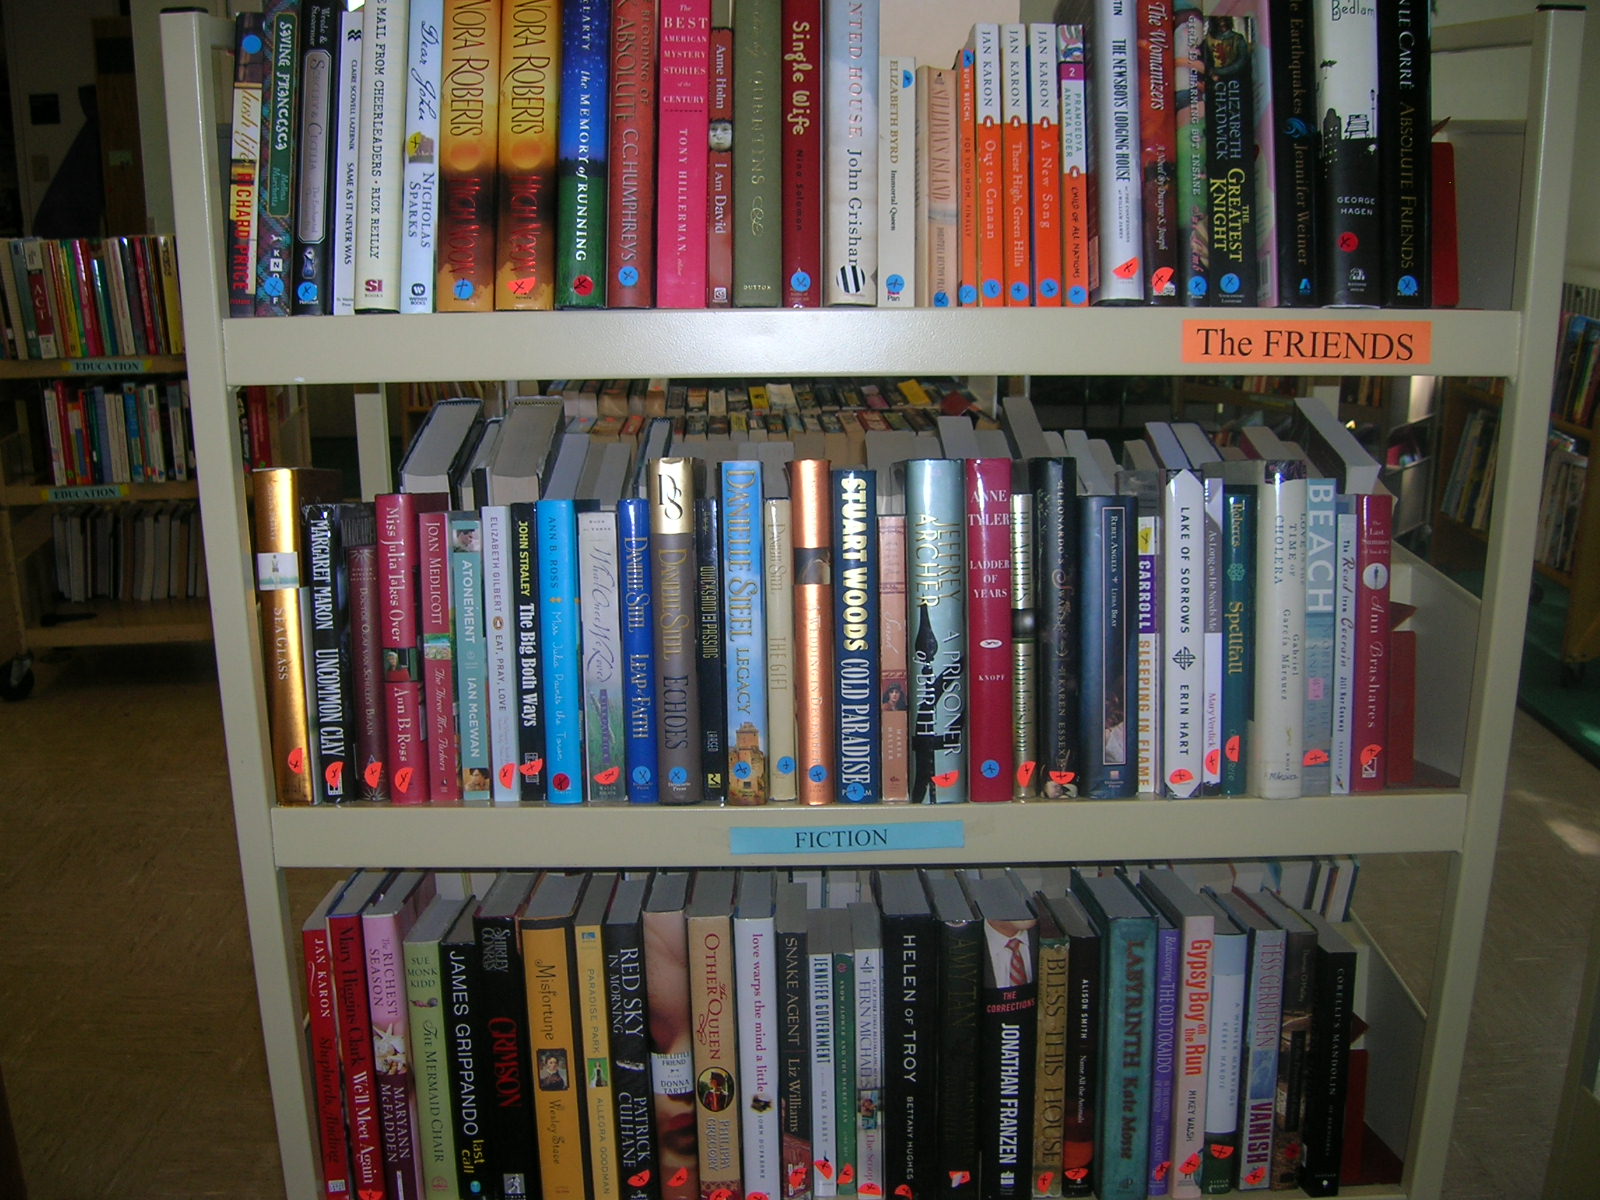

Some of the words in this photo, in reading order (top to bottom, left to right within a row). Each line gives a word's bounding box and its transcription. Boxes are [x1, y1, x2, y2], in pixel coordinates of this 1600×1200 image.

[376, 7, 386, 39] MAIL
[664, 17, 708, 28] BEST
[1148, 3, 1166, 26] The
[374, 44, 385, 76] FROM
[716, 44, 727, 75] Anne
[784, 21, 812, 82] Single
[981, 30, 992, 54] JAN
[1009, 30, 1019, 54] JAN
[1038, 30, 1049, 54] JAN
[580, 70, 591, 89] the
[983, 61, 993, 107] KARON
[1010, 61, 1020, 108] KARON
[1039, 61, 1049, 108] KARON
[1148, 29, 1167, 111] Womanizers
[716, 78, 727, 109] Holm
[787, 90, 811, 135] Wife
[889, 60, 898, 127] ELIZABETH
[371, 80, 384, 176] CHEERLEADERS
[578, 94, 591, 163] MEMORY
[1215, 82, 1227, 160] CHADWICK
[889, 129, 898, 164] BYRD
[1399, 102, 1413, 189] ABSOLUTE
[576, 167, 588, 180] of
[847, 149, 861, 191] John
[1294, 143, 1308, 209] Jennifer
[345, 187, 352, 201] AS
[370, 187, 381, 216] RICK
[408, 181, 422, 238] SPARKS
[420, 171, 435, 248] NICHOLAS
[1210, 178, 1226, 251] KNIGHT
[344, 214, 352, 242] NEVER
[575, 183, 588, 261] RUNNING
[1227, 168, 1245, 262] GREATEST
[1400, 195, 1412, 269] FRIENDS
[344, 244, 352, 265] WAS
[369, 219, 380, 259] REILLY
[1297, 211, 1309, 265] Weiner
[1197, 328, 1252, 356] The
[1263, 330, 1413, 360] FRIENDS
[76, 362, 140, 371] EDUCATION
[54, 488, 116, 499] EDUCATION
[385, 507, 400, 537] Miss
[425, 522, 440, 552] JOAN
[518, 520, 529, 549] JOHN
[725, 469, 757, 573] DANIELLE
[841, 475, 869, 562] STUART
[967, 513, 1010, 526] TYLER
[1180, 507, 1191, 540] LAKE
[310, 519, 329, 583] MARGARET
[381, 539, 405, 569] Julia
[490, 516, 499, 569] ELIZABETH
[915, 513, 939, 609] ARCHER
[1180, 546, 1191, 561] OF
[1308, 484, 1334, 613] BEACH
[519, 551, 531, 596] STRALEY
[969, 560, 1010, 569] LADDER
[313, 586, 333, 630] MARON
[387, 570, 404, 606] Takes
[428, 557, 443, 625] MEDLICOTT
[462, 560, 476, 643] ATONEMENT
[492, 572, 502, 612] GILBERT
[699, 565, 718, 612] QUICKSAND
[972, 589, 1007, 599] YEARS
[1138, 560, 1151, 629] CARROLL
[1180, 567, 1191, 634] SORROWS
[389, 609, 404, 641] Over
[519, 603, 534, 629] The
[729, 577, 758, 642] STEEL
[842, 567, 869, 651] WOODS
[518, 631, 536, 655] Big
[701, 623, 718, 659] PASSING
[942, 629, 960, 643] A
[1224, 602, 1245, 675] Spellfall
[522, 658, 537, 689] Both
[629, 654, 649, 687] LEAP
[841, 658, 870, 700] COLD
[913, 651, 929, 667] of
[1138, 640, 1151, 712] SLEEPING
[315, 649, 342, 722] UNCOMMON
[393, 687, 407, 716] Ann
[467, 677, 478, 700] IAN
[736, 648, 751, 716] LEGACY
[1180, 684, 1190, 715] ERIN
[520, 693, 538, 727] Ways
[631, 697, 650, 739] FAITH
[663, 675, 689, 750] ECHOES
[915, 674, 936, 736] BIRTH
[942, 651, 961, 756] PRISONER
[1206, 692, 1217, 715] Mary
[320, 727, 345, 757] CLAY
[397, 719, 409, 732] B.
[468, 703, 480, 758] McEWAN
[842, 703, 871, 784] PARADISE
[1138, 718, 1150, 733] IN
[1179, 722, 1189, 755] HART
[1207, 716, 1217, 748] Verdick
[397, 733, 410, 762] Ross
[1138, 740, 1150, 787] FLAME
[795, 829, 888, 848] FICTION
[315, 938, 326, 964] JAN
[608, 954, 619, 968] IN
[752, 934, 763, 957] love
[785, 937, 799, 989] SNAKE
[1186, 939, 1211, 989] Gypsy
[368, 948, 383, 1007] SEASON
[382, 952, 398, 1017] RICHEST
[449, 951, 469, 1016] JAMES
[620, 948, 640, 991] RED
[750, 961, 763, 997] warps
[813, 958, 829, 1000] JENNIFER
[903, 935, 916, 1001] HELEN
[317, 971, 331, 1018] KARON
[608, 973, 624, 1034] MORNING
[754, 1000, 765, 1019] the
[858, 981, 872, 1017] FERN
[1080, 979, 1089, 1010] ALISON
[1123, 939, 1145, 1068] LABYRINTH
[1184, 992, 1210, 1021] Boy
[624, 998, 643, 1038] SKY
[755, 1022, 766, 1051] mind
[787, 993, 800, 1046] AGENT
[815, 1005, 830, 1064] GOVERNMENT
[904, 1008, 913, 1025] OF
[1080, 1013, 1088, 1039] SMITH
[488, 1017, 520, 1107] CRIMSON
[788, 1057, 800, 1078] Liz
[859, 1021, 873, 1089] MICHAELS
[903, 1031, 916, 1082] TROY
[999, 1023, 1020, 1095] JONATHAN
[1185, 1045, 1206, 1076] Run
[352, 1071, 371, 1104] We'll
[455, 1024, 479, 1136] GRIPPANDO
[756, 1065, 767, 1092] little
[356, 1106, 372, 1139] Meet
[393, 1087, 410, 1160] MARYANN
[789, 1080, 801, 1133] Williams
[906, 1096, 914, 1139] BETTANY
[618, 1092, 636, 1167] CULHANE
[634, 1096, 651, 1161] PATRICK
[998, 1098, 1019, 1164] FRANZEN
[1247, 1102, 1273, 1165] VANISH
[357, 1145, 376, 1184] Again
[461, 1149, 475, 1173] call
[472, 1139, 486, 1164] last
[906, 1141, 914, 1180] HUGHES
